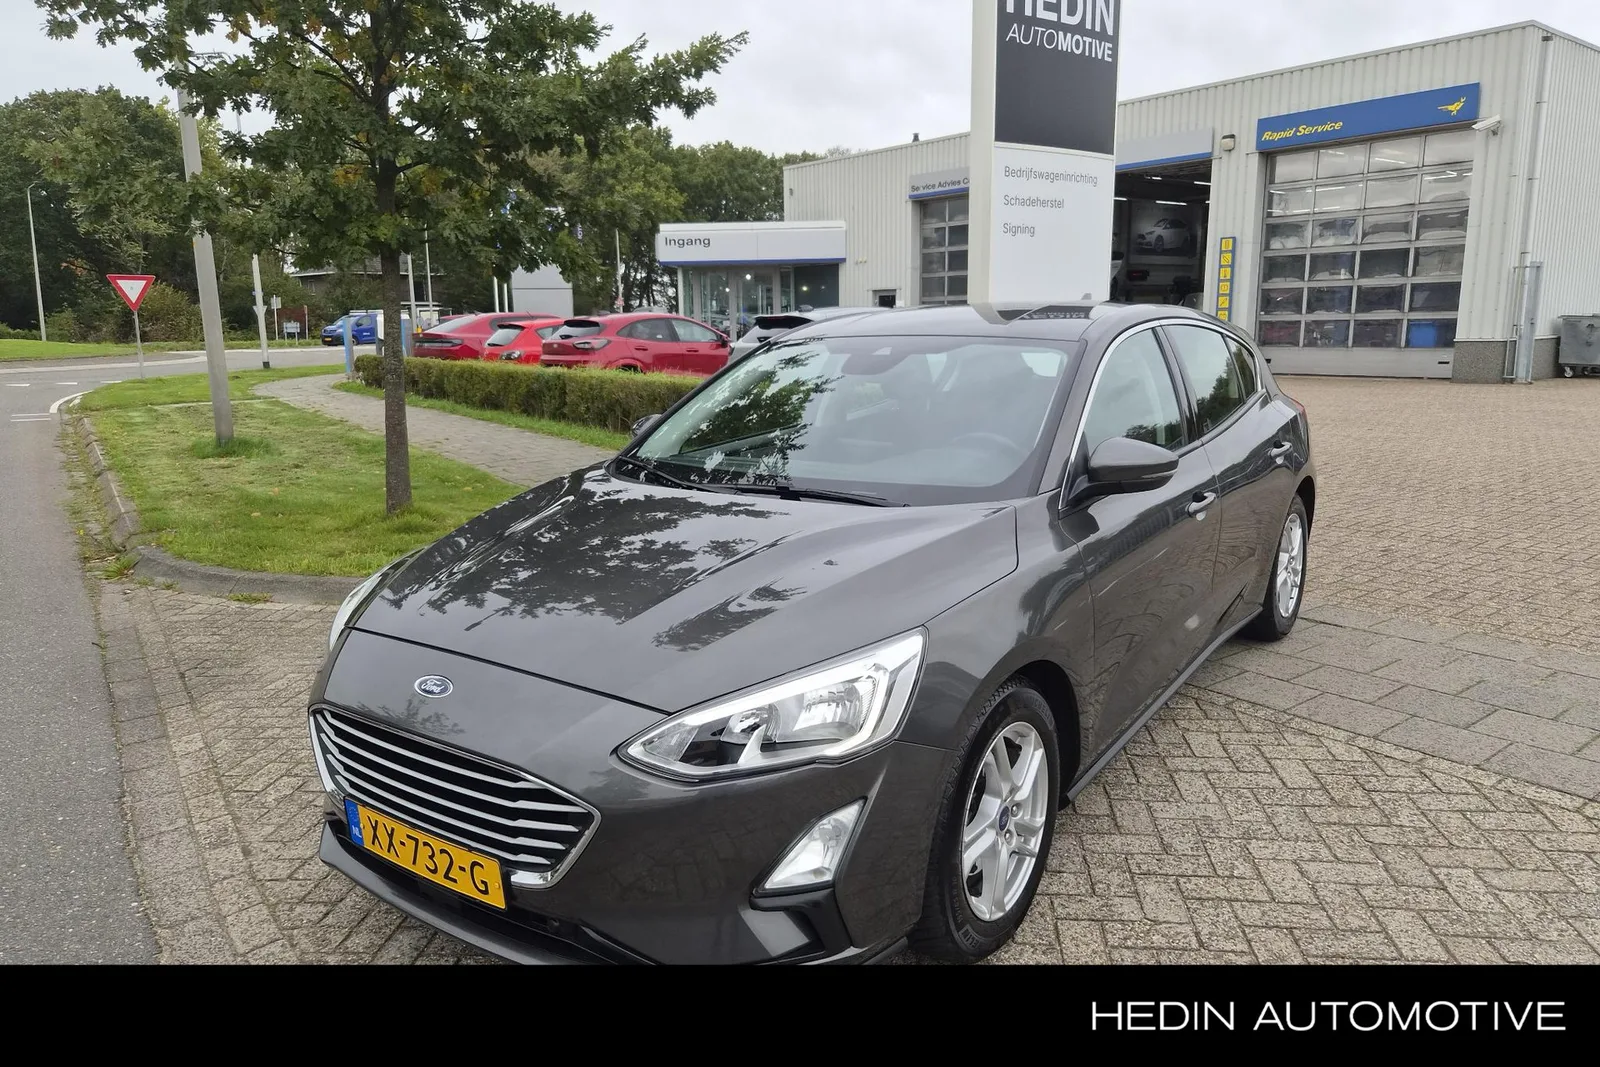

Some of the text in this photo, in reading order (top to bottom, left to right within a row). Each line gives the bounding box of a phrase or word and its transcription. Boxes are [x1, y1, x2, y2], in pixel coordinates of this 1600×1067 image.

[1006, 23, 1113, 62] AUTOMOTIVE
[1261, 121, 1344, 142] Rapid Service
[1004, 165, 1098, 187] Bedrijfswageninrichting
[1003, 194, 1065, 209] Schadeherstel
[1002, 223, 1035, 238] Signing
[665, 236, 711, 248] Ingang
[420, 678, 444, 693] Ford
[366, 815, 490, 896] XX-732-G
